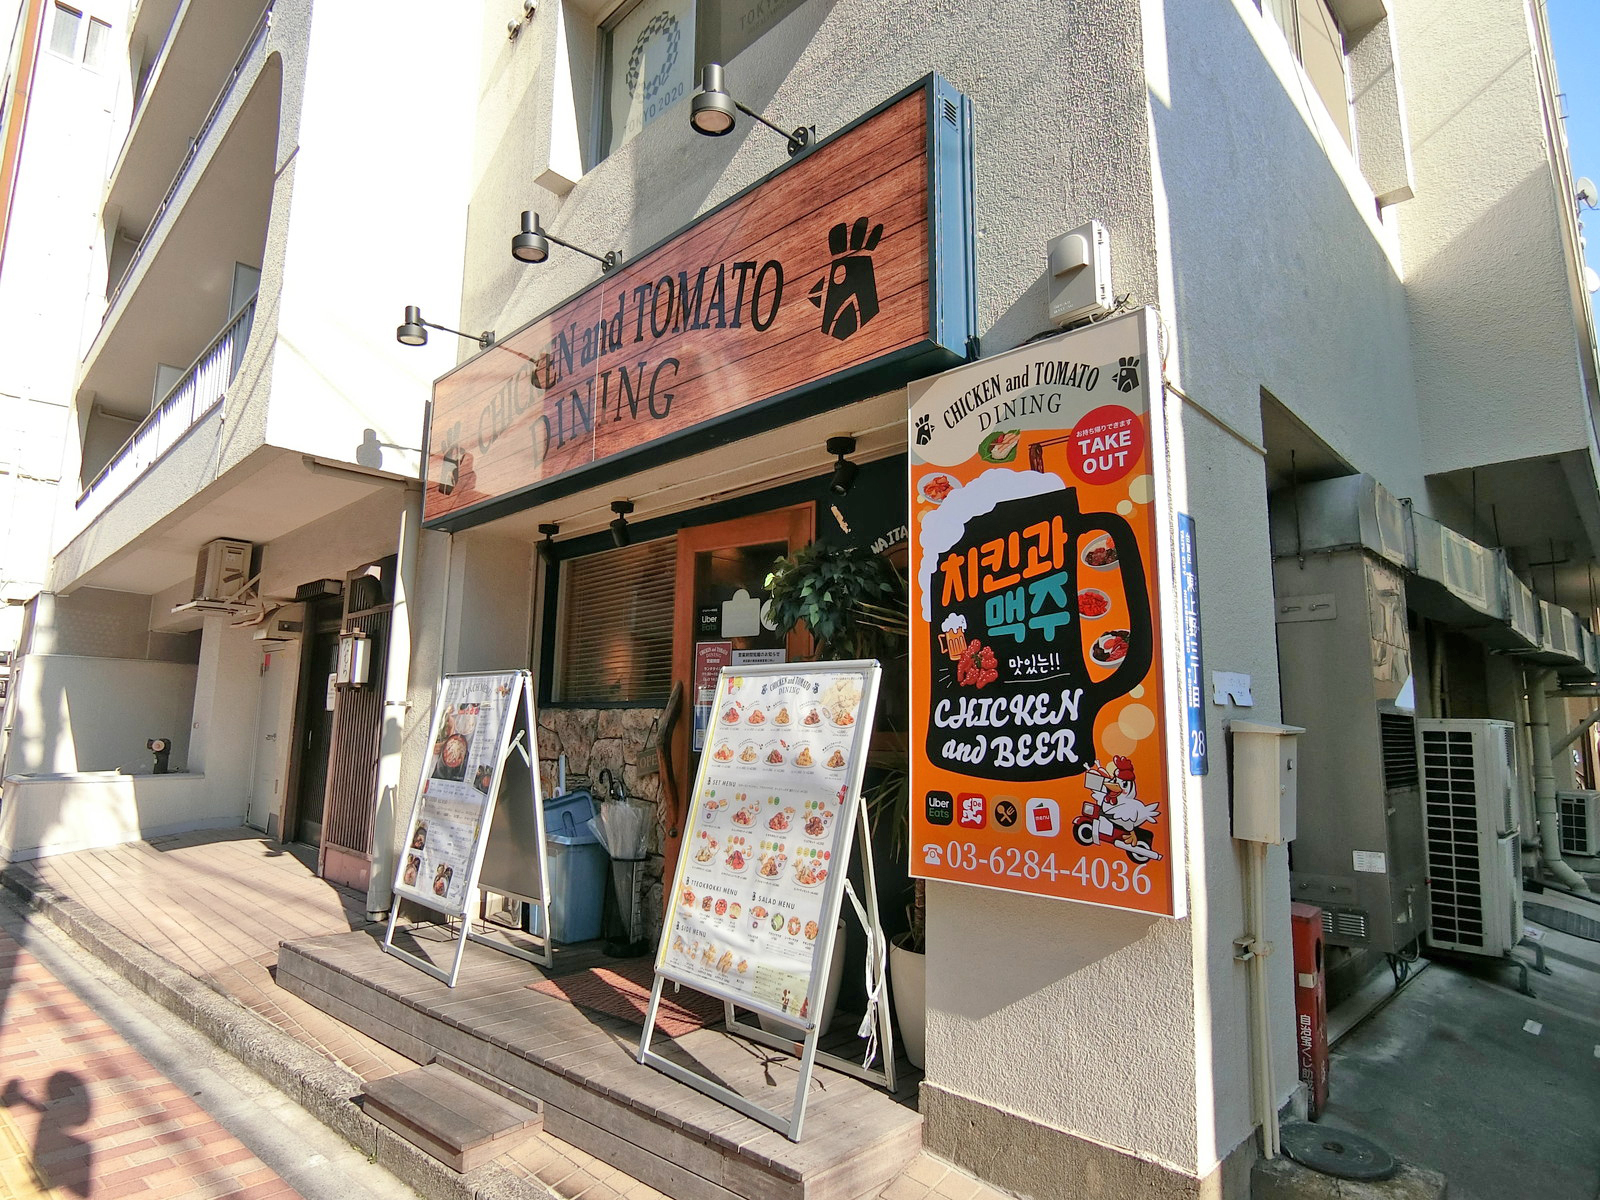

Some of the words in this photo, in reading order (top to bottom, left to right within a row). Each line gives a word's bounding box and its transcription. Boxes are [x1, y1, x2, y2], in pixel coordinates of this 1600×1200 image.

[659, 82, 684, 112] 2020
[478, 321, 576, 455] CHICKEN
[581, 290, 625, 368] and
[633, 259, 784, 343] TOMATO
[943, 374, 1002, 429] CHICKEN
[1006, 365, 1029, 392] and
[1035, 361, 1100, 392] TOMATO
[529, 357, 680, 469] DINING
[978, 393, 1062, 432] DINING
[1076, 418, 1132, 438] お持ち帰りできます
[1077, 430, 1132, 455] TAKE
[1083, 450, 1128, 474] OUT
[940, 515, 1068, 607] 치킨과
[701, 615, 718, 623] Uber
[985, 571, 1071, 643] 맥주
[1008, 652, 1060, 675] 맛있는!!
[769, 677, 788, 692] CHICKEN
[795, 677, 811, 691] TOMATO
[779, 686, 800, 696] DINING
[934, 688, 1084, 729] CHICKEN
[942, 734, 987, 765] and
[990, 728, 1079, 768] BEER
[1191, 730, 1206, 758] 28
[928, 797, 949, 808] Uber
[928, 807, 950, 818] Eats
[946, 840, 1152, 895] 03-6284-4036
[691, 880, 722, 892] TTEOKBOKKI
[723, 887, 738, 896] MENU
[758, 896, 777, 905] SALAD
[778, 900, 796, 910] MENU
[681, 925, 692, 934] SIDE
[693, 929, 707, 938] MENU
